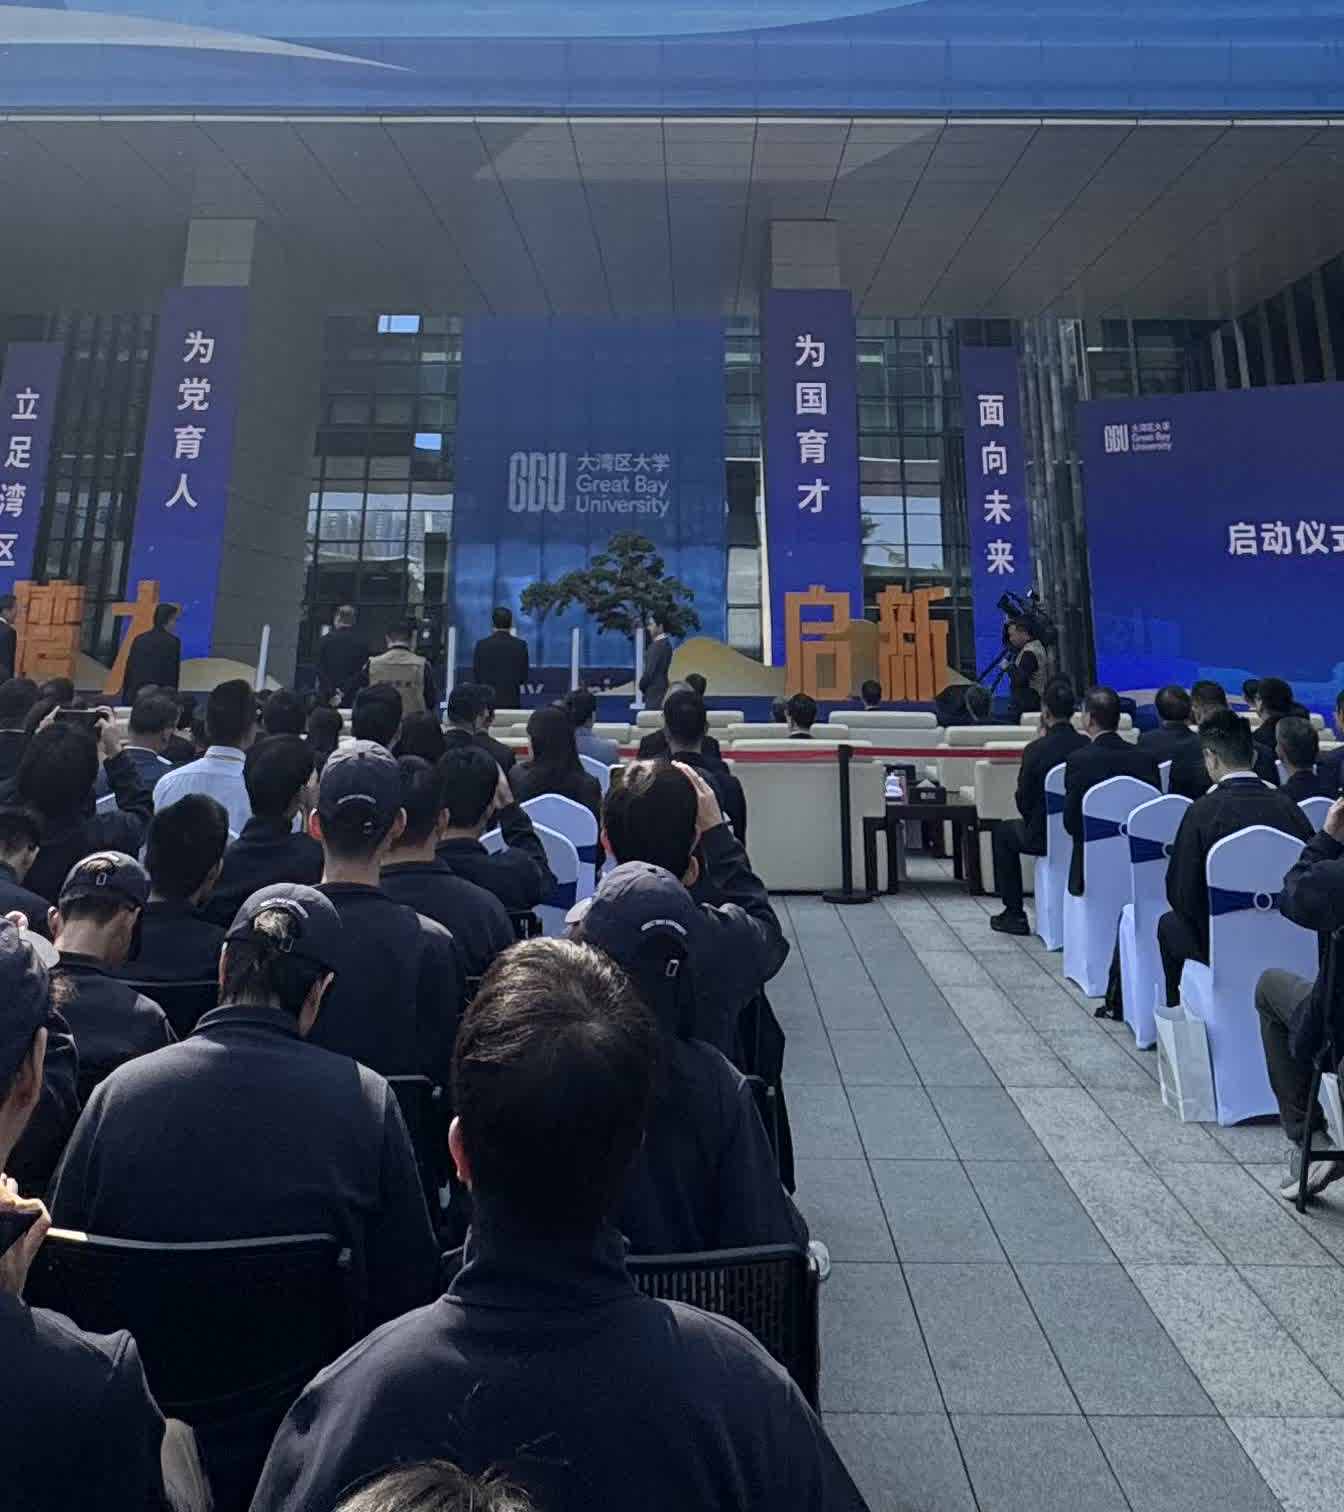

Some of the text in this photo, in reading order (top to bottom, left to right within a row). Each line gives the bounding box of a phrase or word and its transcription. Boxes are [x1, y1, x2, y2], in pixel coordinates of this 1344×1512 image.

[165, 330, 215, 509] 为党育人
[576, 452, 671, 473] 大湾区大学
[795, 334, 830, 514] 为国育才
[575, 474, 670, 498] Great Bay
[575, 494, 671, 518] University
[977, 394, 1015, 575] 面向未来
